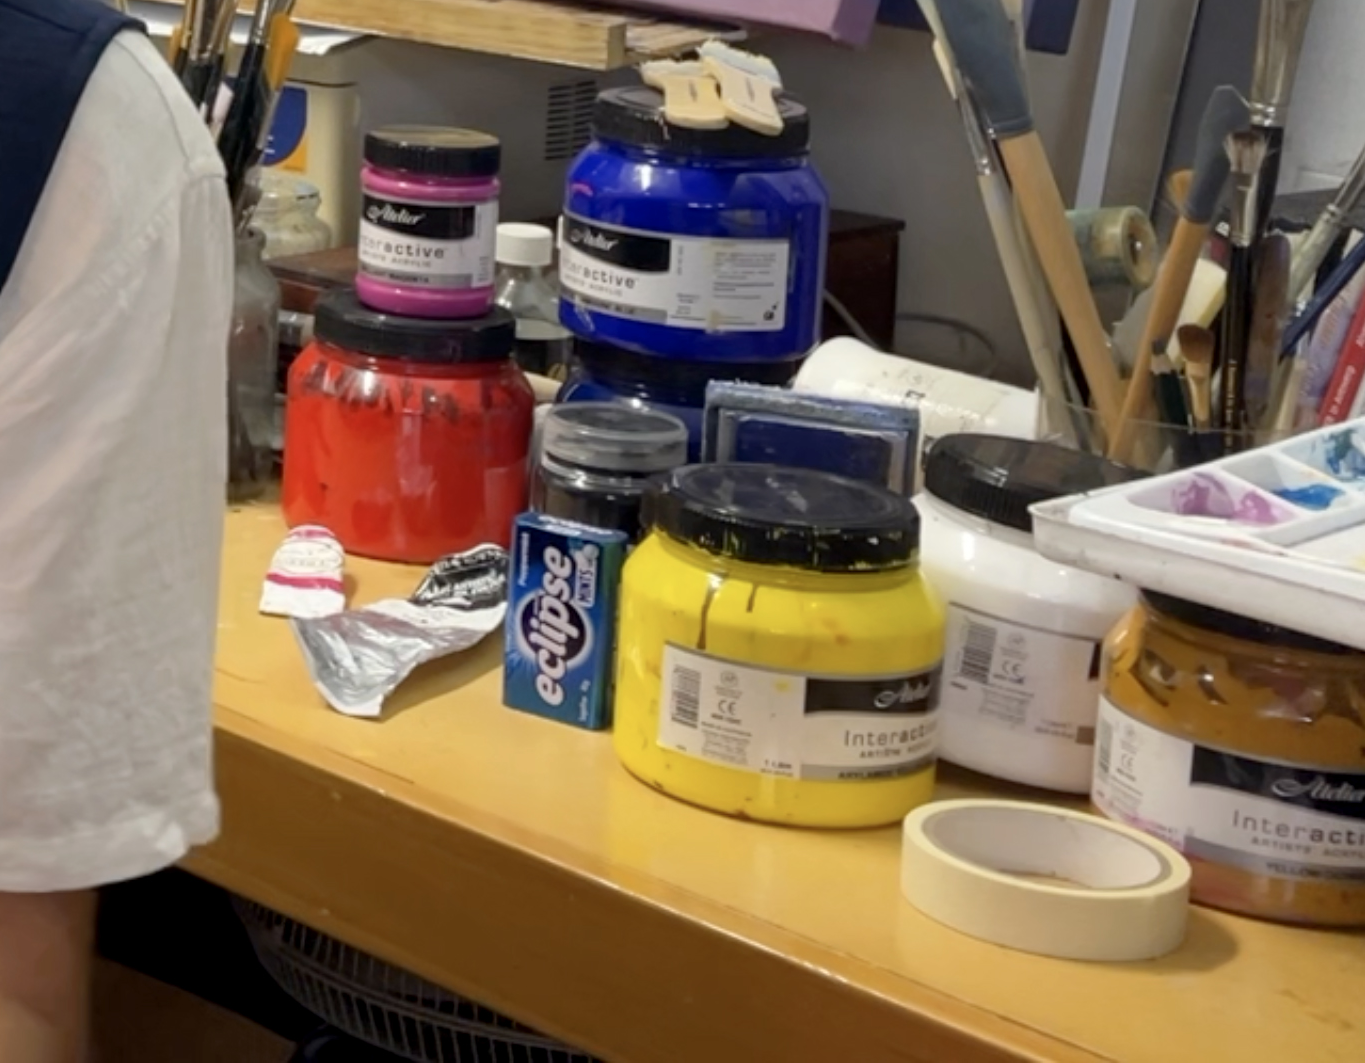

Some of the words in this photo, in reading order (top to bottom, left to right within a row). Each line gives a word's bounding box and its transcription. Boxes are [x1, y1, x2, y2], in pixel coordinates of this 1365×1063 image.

[367, 203, 427, 225] Atelier
[578, 569, 594, 603] MINTS
[530, 545, 580, 706] eclipse
